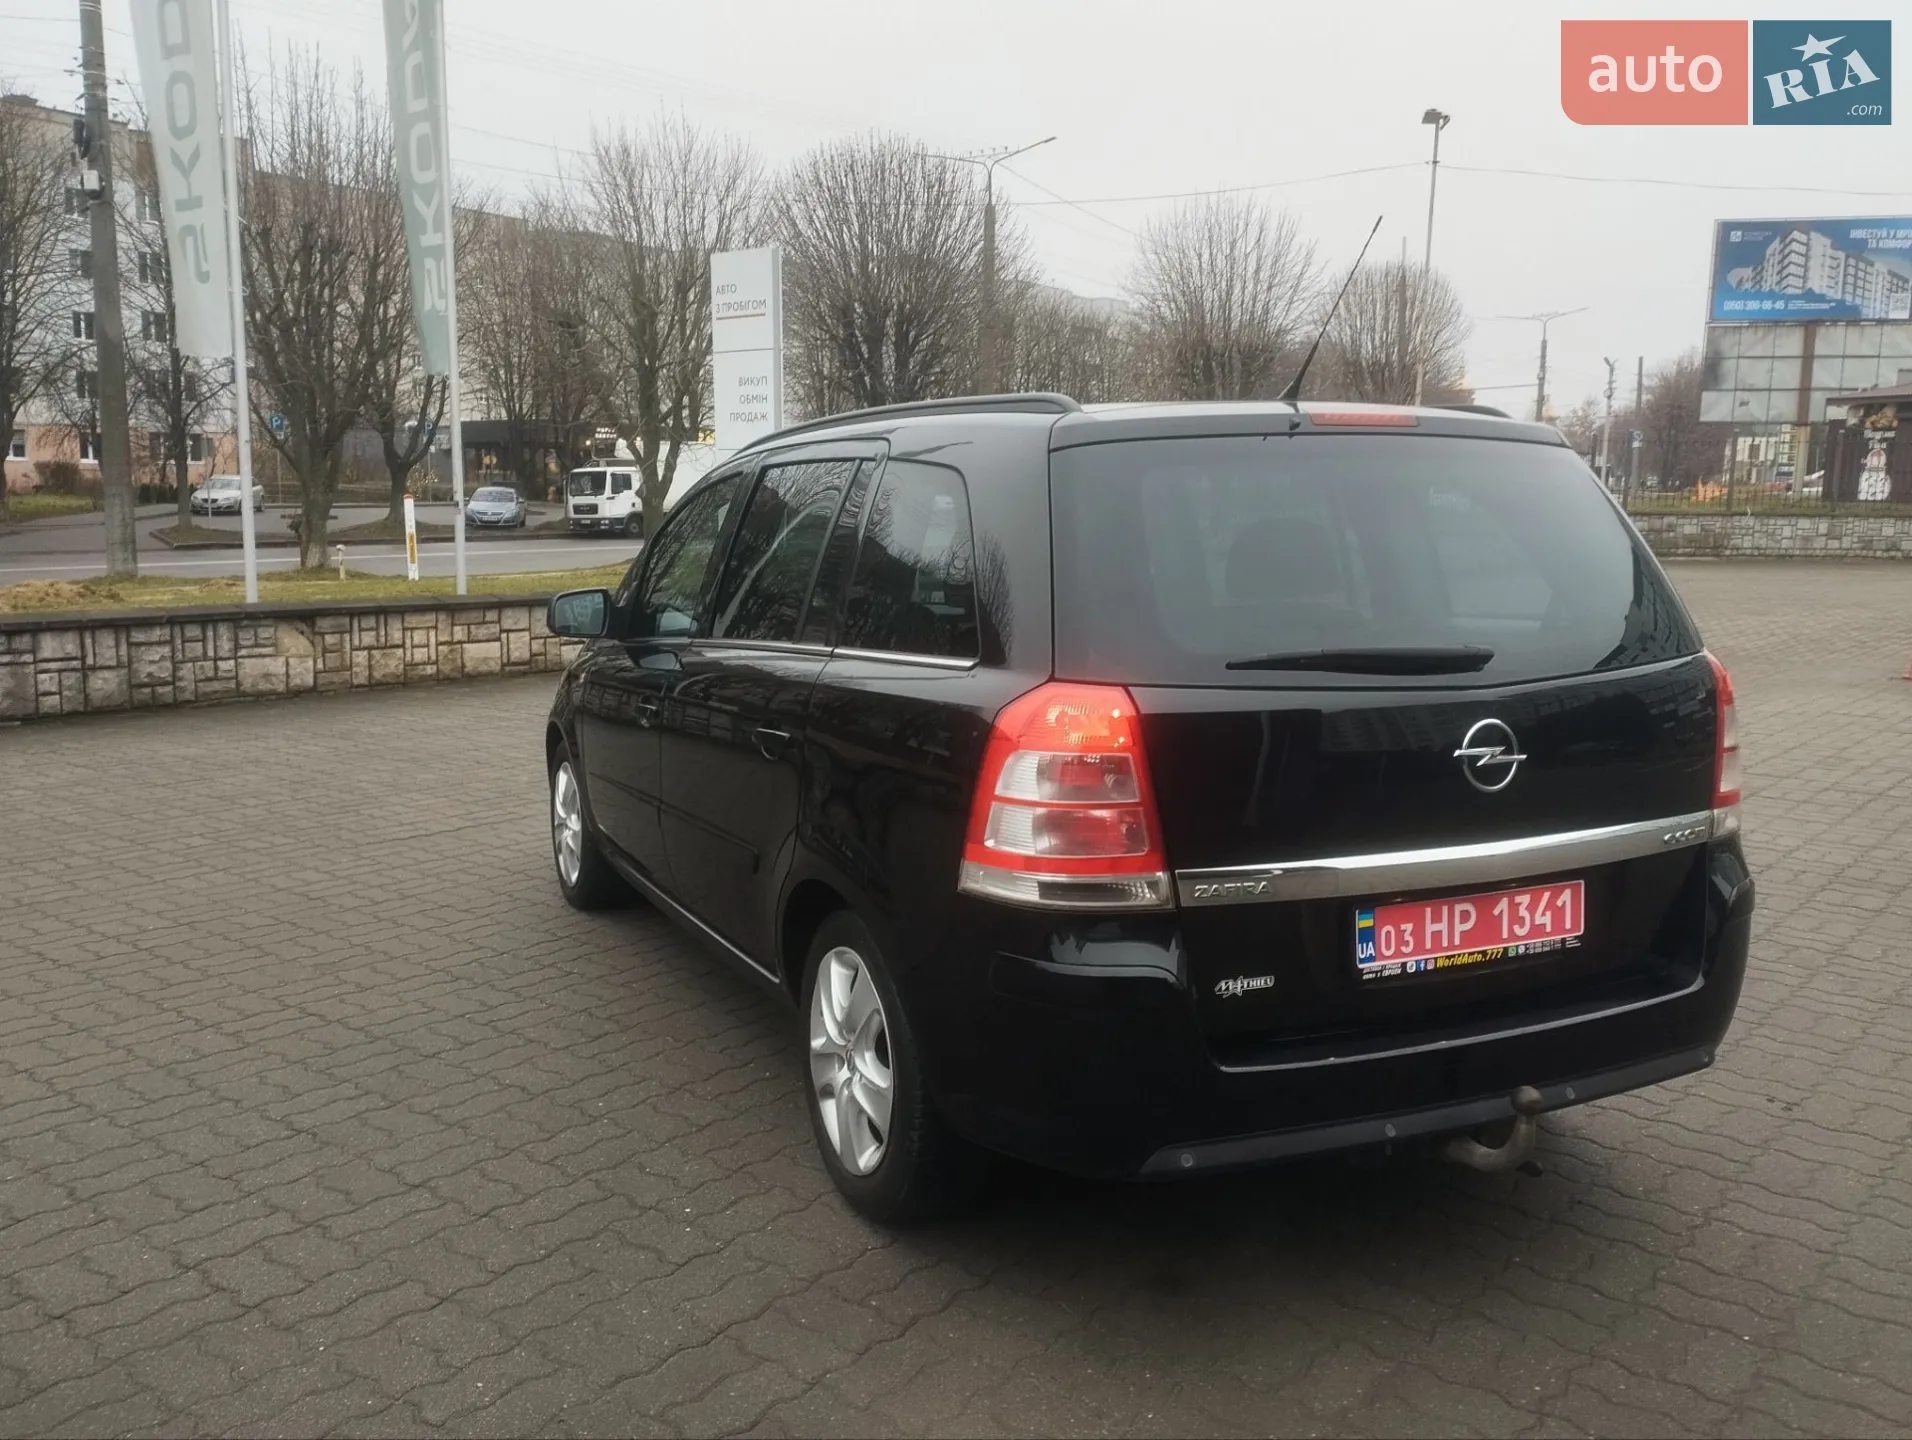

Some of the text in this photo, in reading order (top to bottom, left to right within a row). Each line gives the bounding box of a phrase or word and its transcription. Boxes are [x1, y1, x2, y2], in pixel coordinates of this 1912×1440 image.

[716, 283, 737, 296] АВТО
[722, 298, 767, 313] ПРОБІГОМ
[738, 376, 768, 387] ВИКУП
[739, 394, 768, 404] ОБМІН
[729, 412, 768, 423] ПРОДАЖ
[1194, 881, 1273, 898] ZAFIRA
[1380, 888, 1573, 957] 03 HP 1341
[1358, 941, 1376, 959] UA
[1436, 948, 1504, 969] WorldAuto.777
